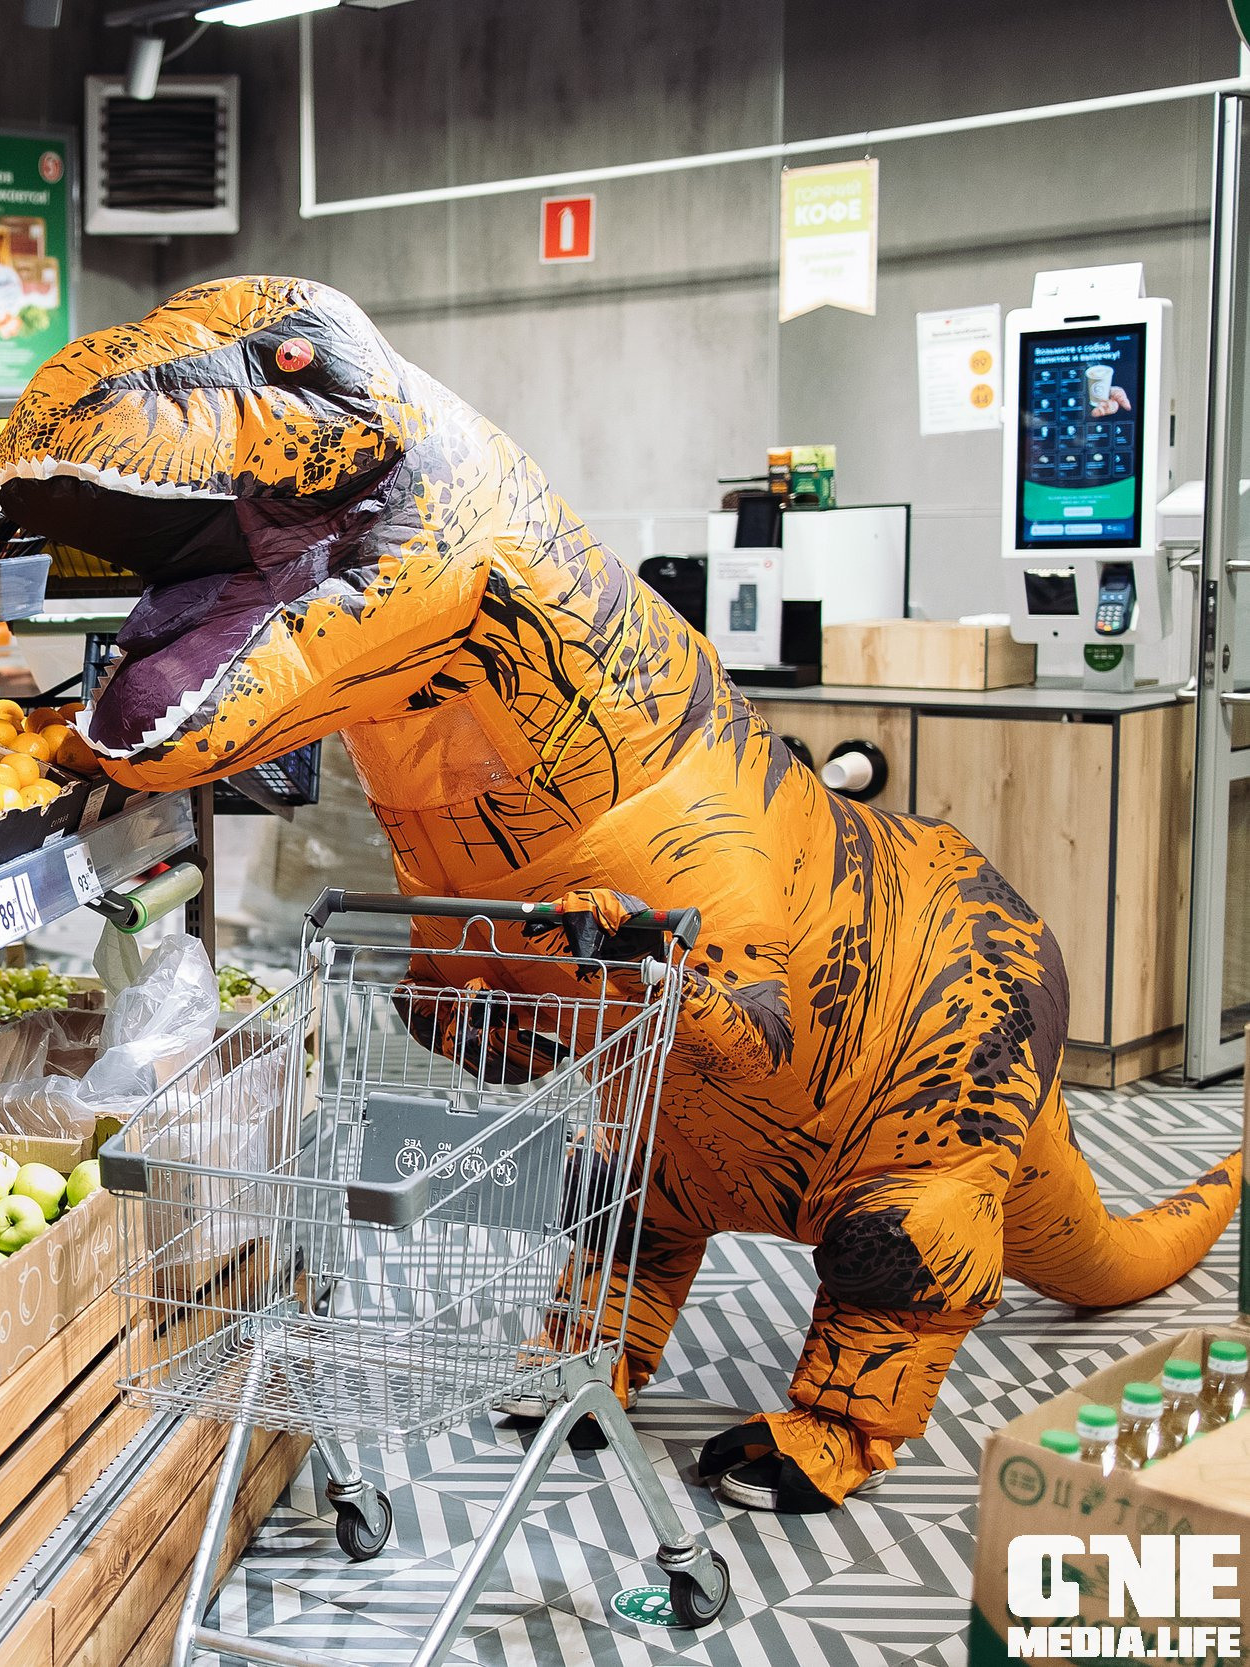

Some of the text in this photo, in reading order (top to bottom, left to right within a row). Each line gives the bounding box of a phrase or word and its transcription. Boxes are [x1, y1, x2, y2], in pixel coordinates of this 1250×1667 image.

[794, 198, 862, 227] КОФЕ
[78, 874, 89, 892] 93
[0, 901, 16, 930] 89
[404, 1138, 422, 1148] YES
[438, 1143, 452, 1151] NO
